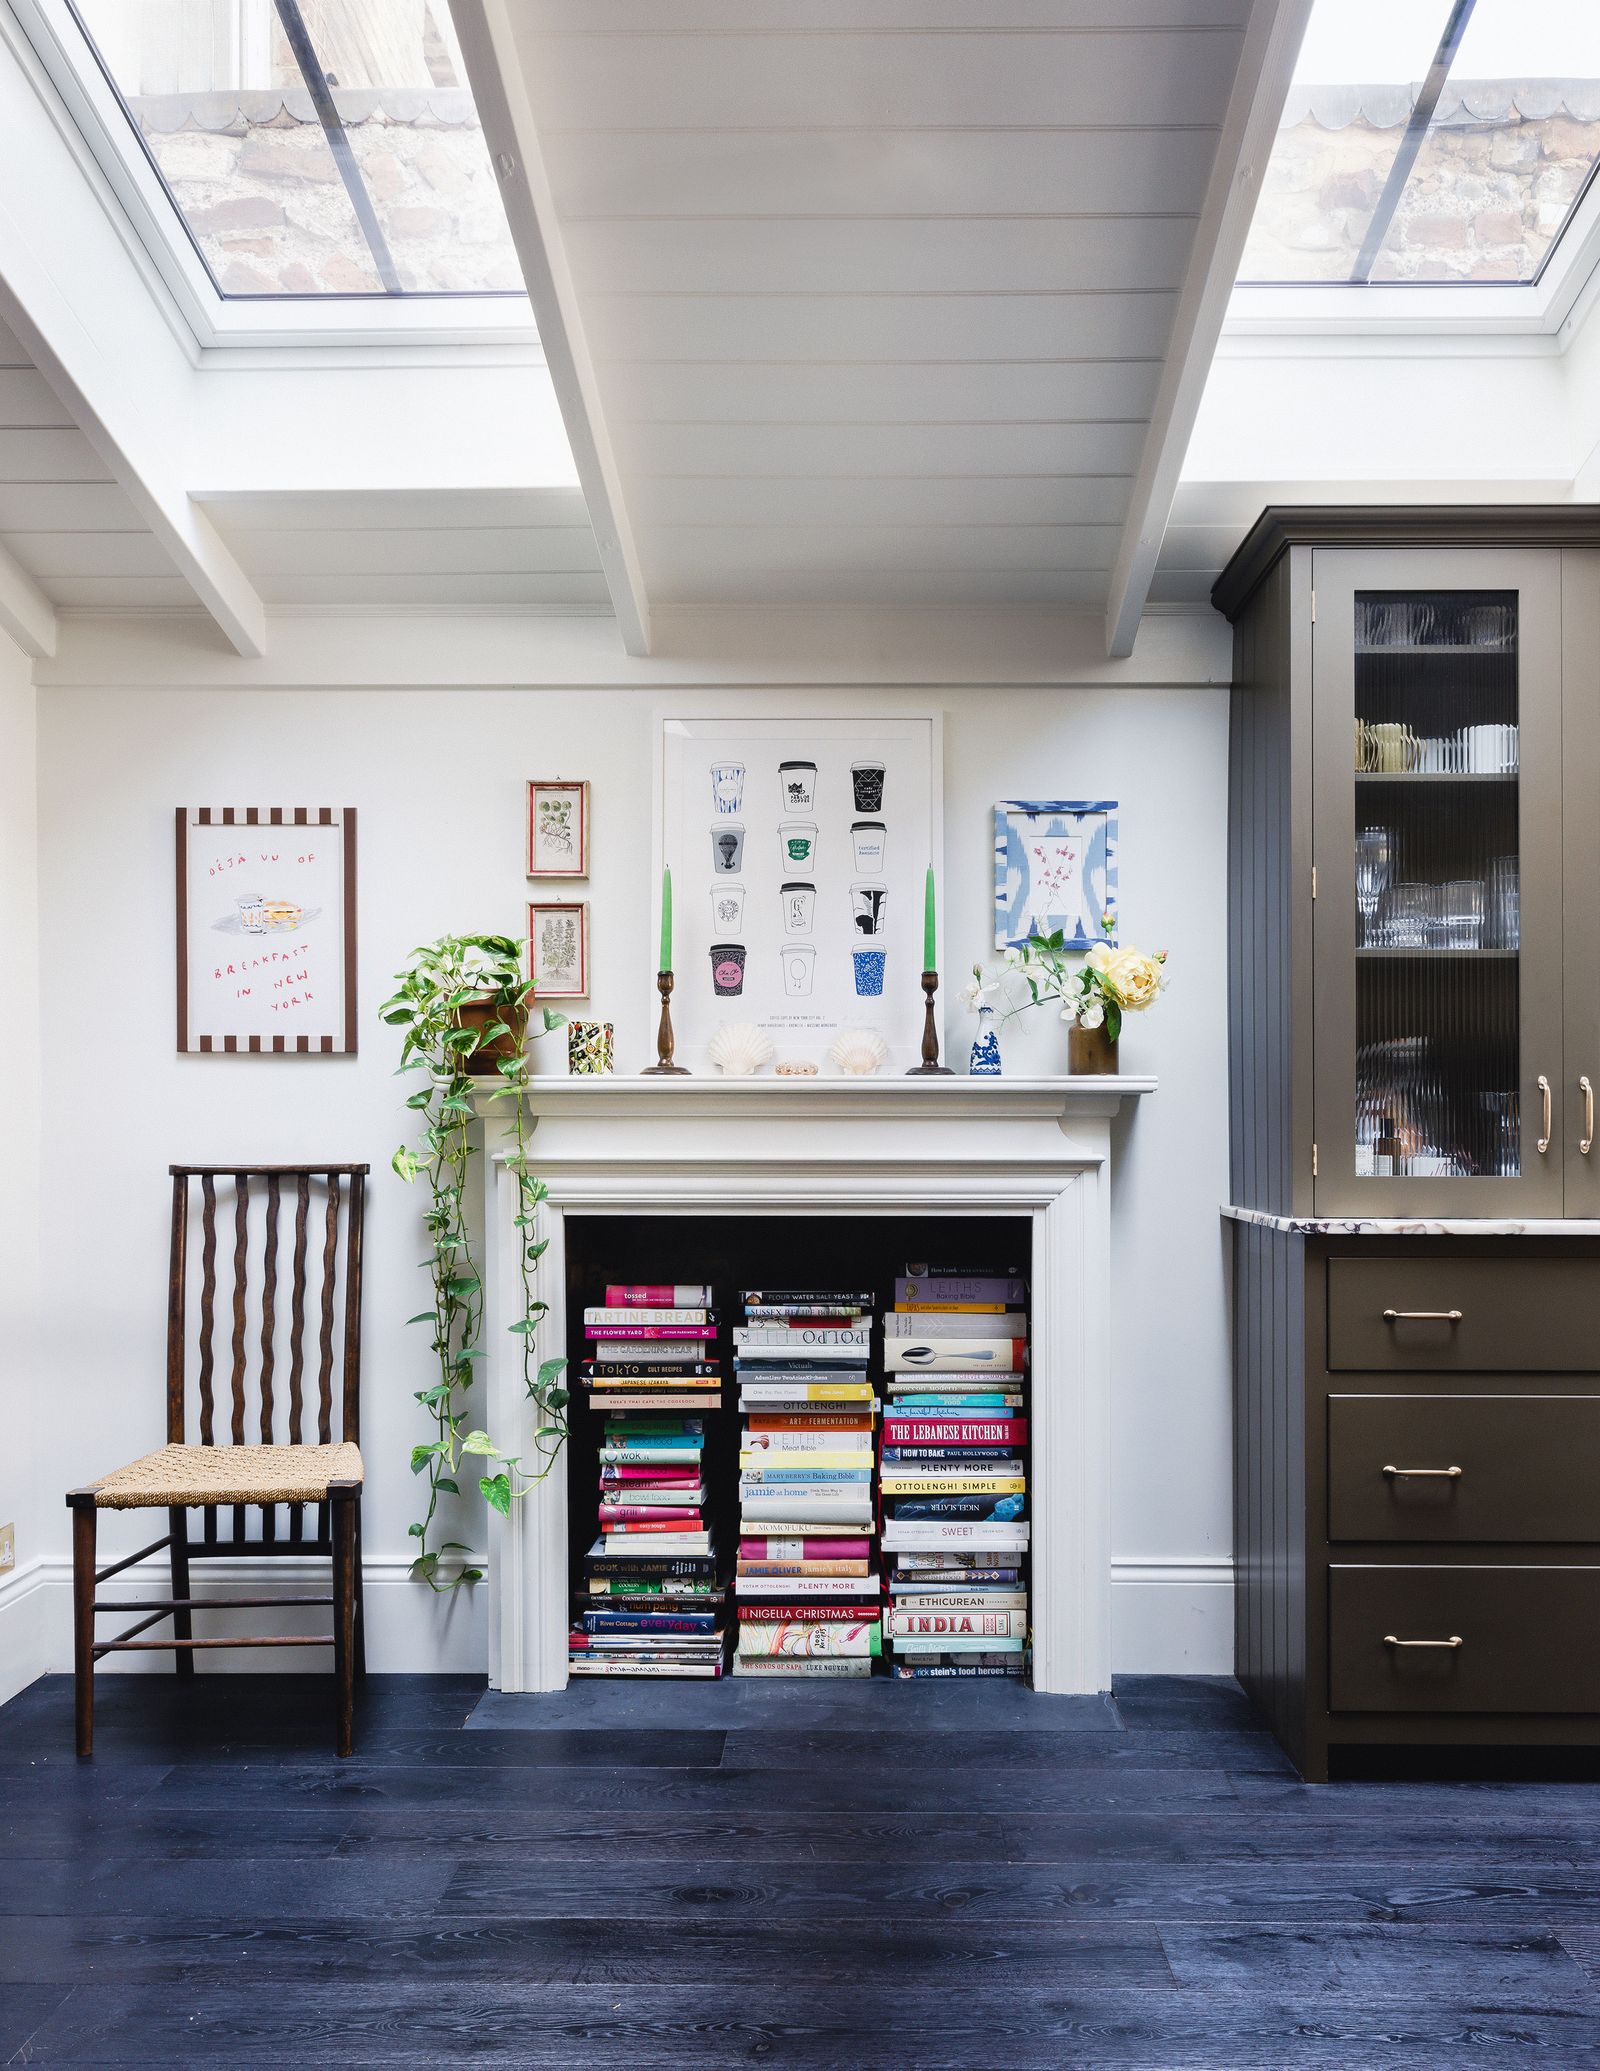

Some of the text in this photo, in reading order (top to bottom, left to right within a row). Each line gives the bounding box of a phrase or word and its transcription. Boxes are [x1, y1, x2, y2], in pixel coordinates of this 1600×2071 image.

[209, 853, 315, 876] DÉJÀ VU OF
[214, 945, 308, 979] BREAKFAST
[236, 970, 308, 998] IN NEW
[271, 992, 313, 1011] YORK
[930, 1282, 982, 1293] LEITHS
[586, 1312, 704, 1322] TARTINE BREAD
[803, 1330, 864, 1344] POLPO
[600, 1345, 692, 1354] THE GARDENING YEAR
[783, 1402, 846, 1410] OTTOLENGHI
[891, 1424, 1003, 1440] THE LEBANESE KITCHEN
[773, 1434, 825, 1445] LEITHS
[620, 1452, 642, 1460] wok
[902, 1449, 918, 1458] HOW
[919, 1449, 928, 1458] TO
[928, 1449, 945, 1458] BAKE
[920, 1464, 961, 1472] PLENTY
[964, 1464, 994, 1472] MORE
[812, 1472, 836, 1480] Baking
[838, 1472, 854, 1480] Bible
[620, 1480, 650, 1488] steam
[744, 1487, 776, 1498] jamie
[784, 1488, 808, 1496] home
[620, 1508, 638, 1518] grill
[758, 1524, 812, 1532] MOMOFUKU
[942, 1528, 974, 1536] SWEET
[594, 1564, 668, 1572] COOK with JAMIE
[745, 1567, 769, 1575] JAMIE
[804, 1565, 832, 1573] jamie's
[836, 1564, 853, 1572] italy
[919, 1598, 984, 1606] ETHICUREAN
[653, 1603, 678, 1612] pang
[750, 1610, 792, 1618] NIGELLA
[796, 1610, 854, 1618] CHRISTMAS
[640, 1618, 696, 1631] everyday
[907, 1616, 974, 1633] INDIA
[918, 1666, 1004, 1676] rick stein's food heroes
